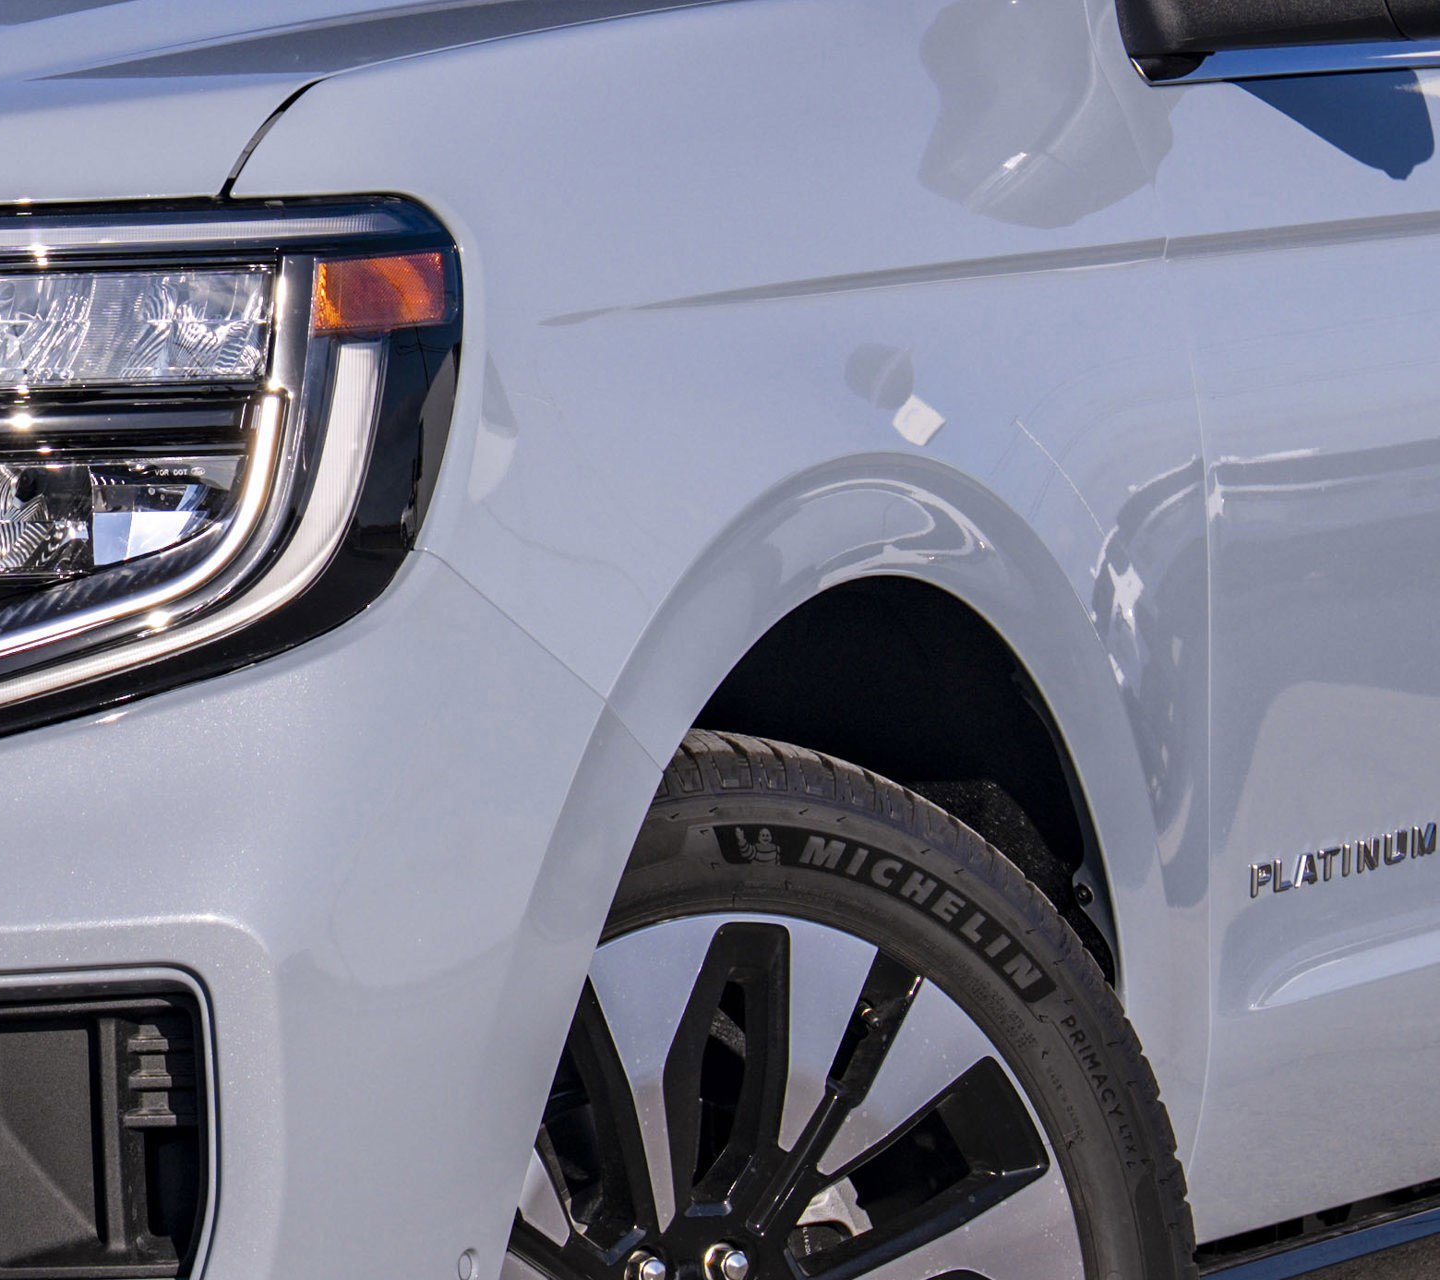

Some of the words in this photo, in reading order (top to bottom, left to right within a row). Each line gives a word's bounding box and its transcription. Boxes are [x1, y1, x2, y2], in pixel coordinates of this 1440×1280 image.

[798, 834, 1043, 990] MICHELIN
[1248, 821, 1438, 899] PLATINUM
[1060, 1014, 1125, 1117] PRIMACY
[1119, 1123, 1138, 1154] LTX
